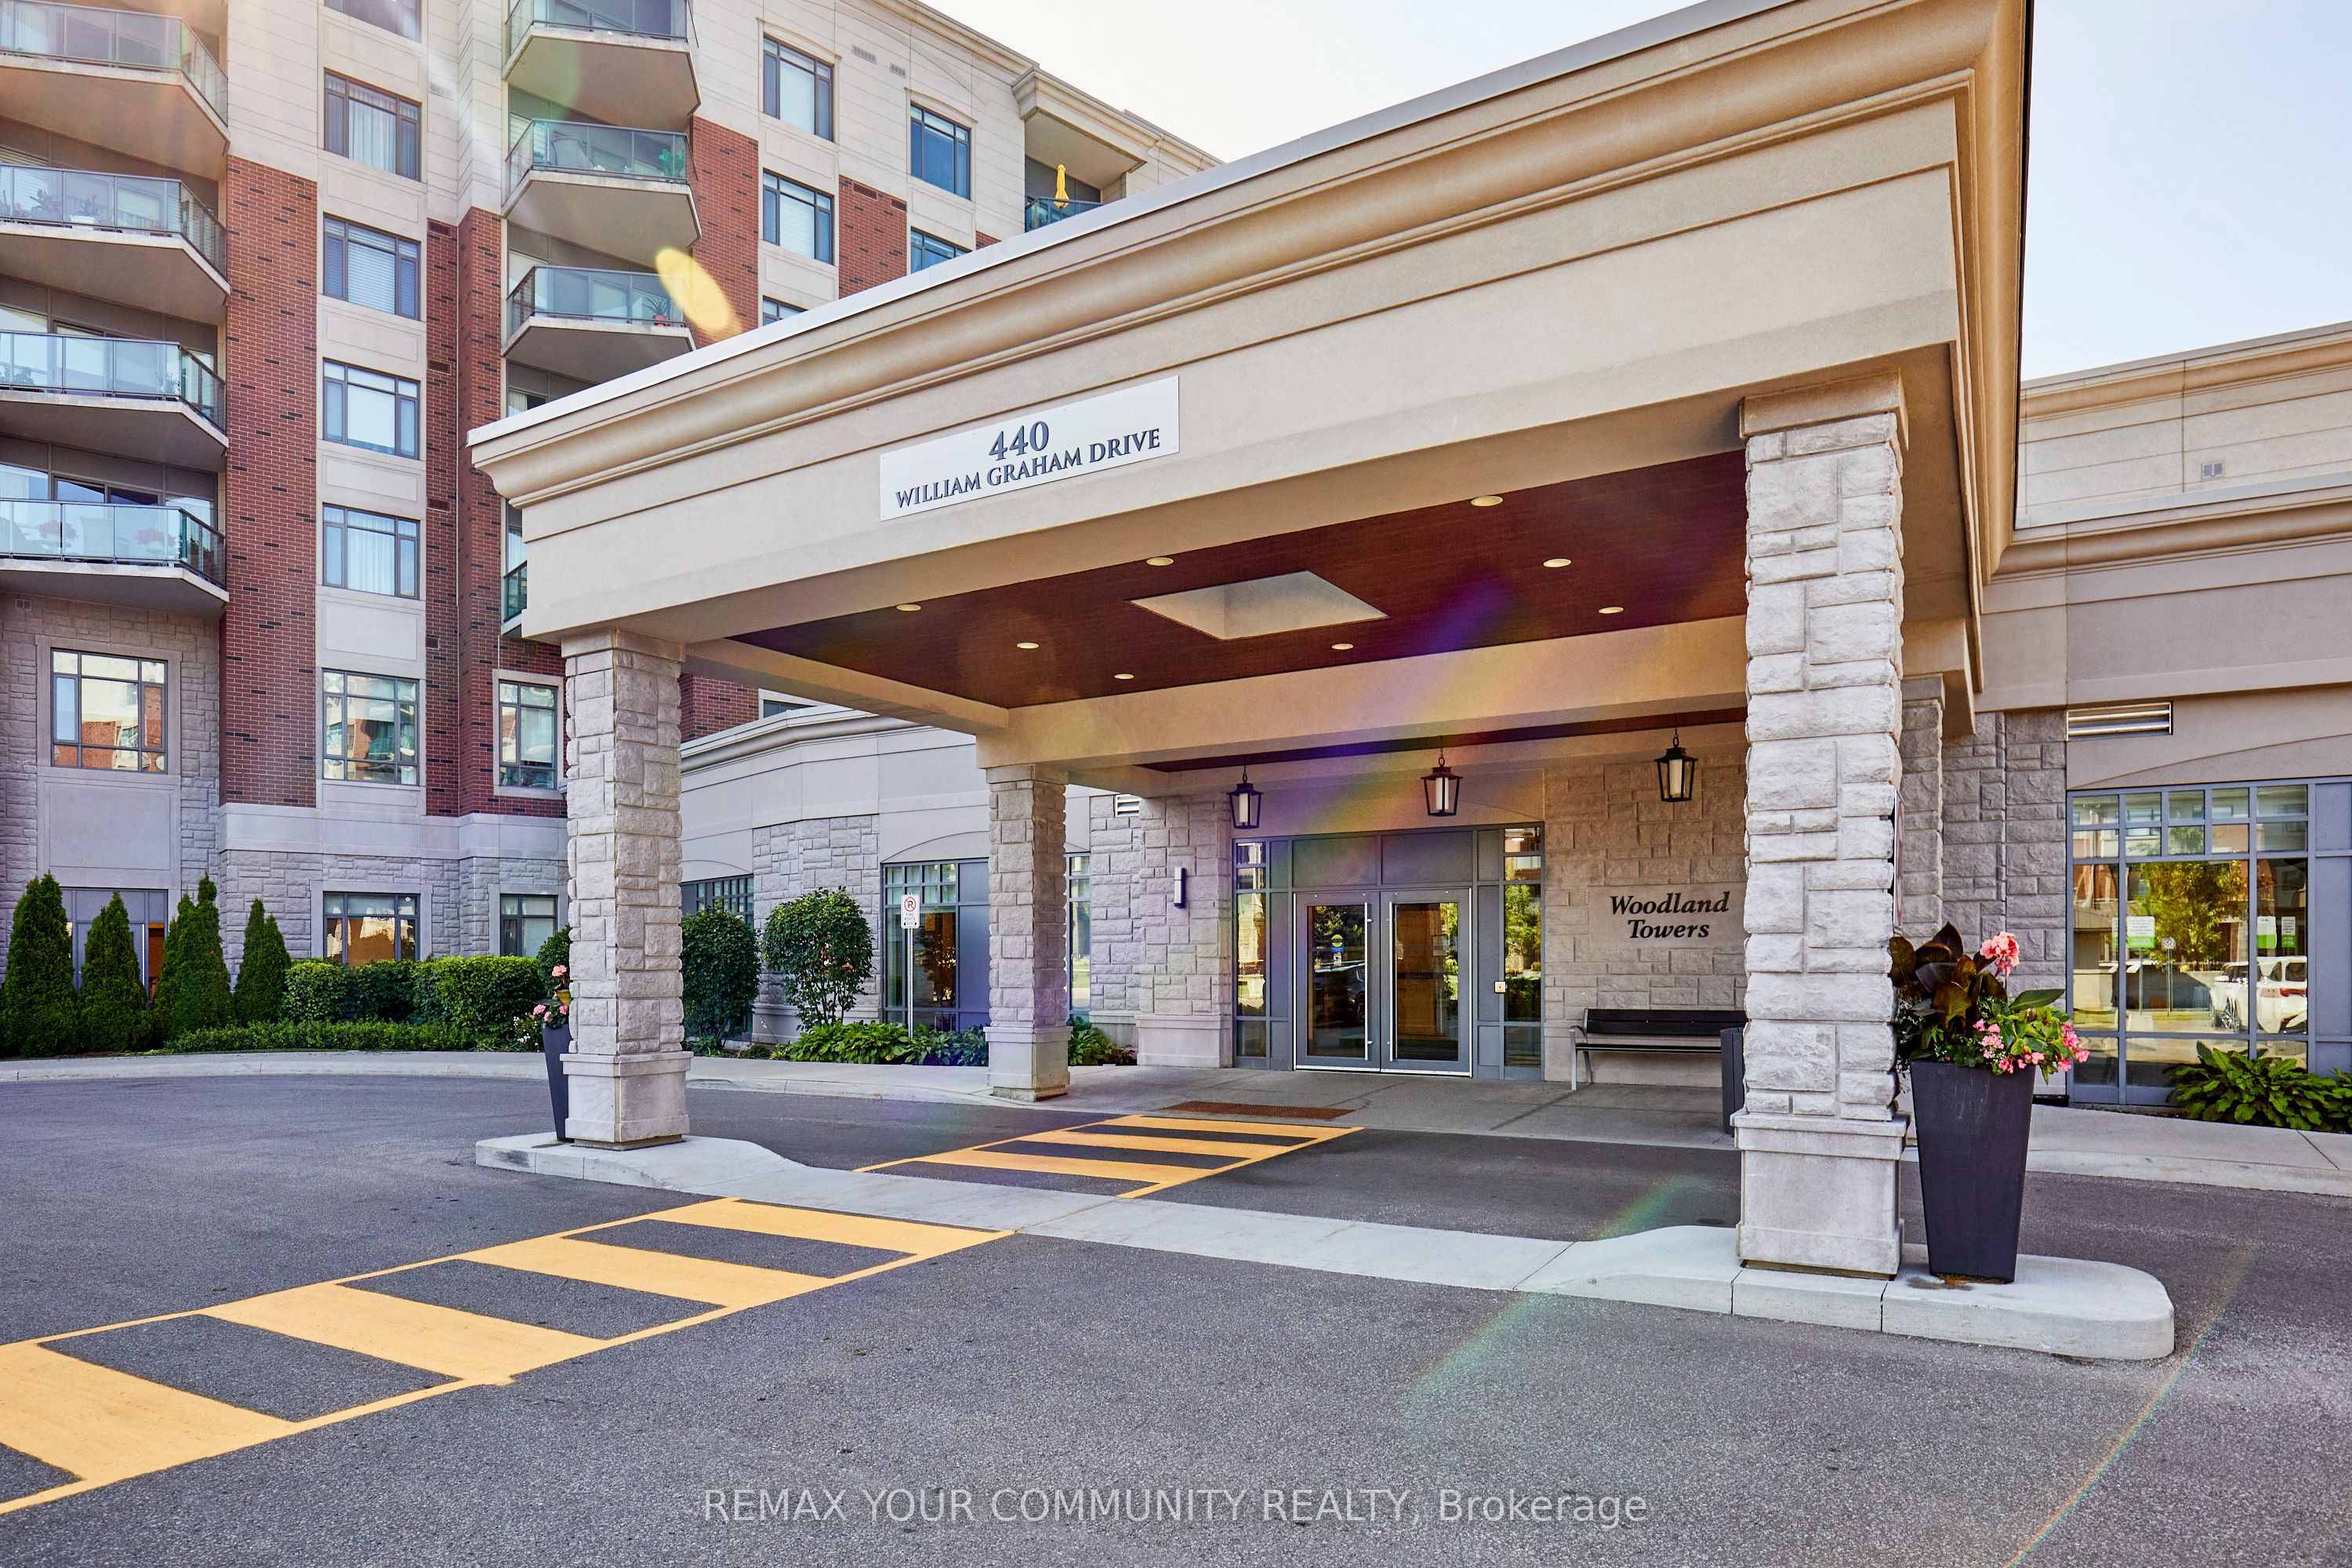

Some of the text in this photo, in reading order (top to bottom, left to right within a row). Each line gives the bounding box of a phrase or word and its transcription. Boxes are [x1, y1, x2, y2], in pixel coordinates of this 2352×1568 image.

[989, 421, 1049, 461] 440
[895, 428, 1160, 508] WILLIAM GRAHAM DRIVE
[1610, 891, 1730, 915] Woodland
[1628, 919, 1710, 938] Towers
